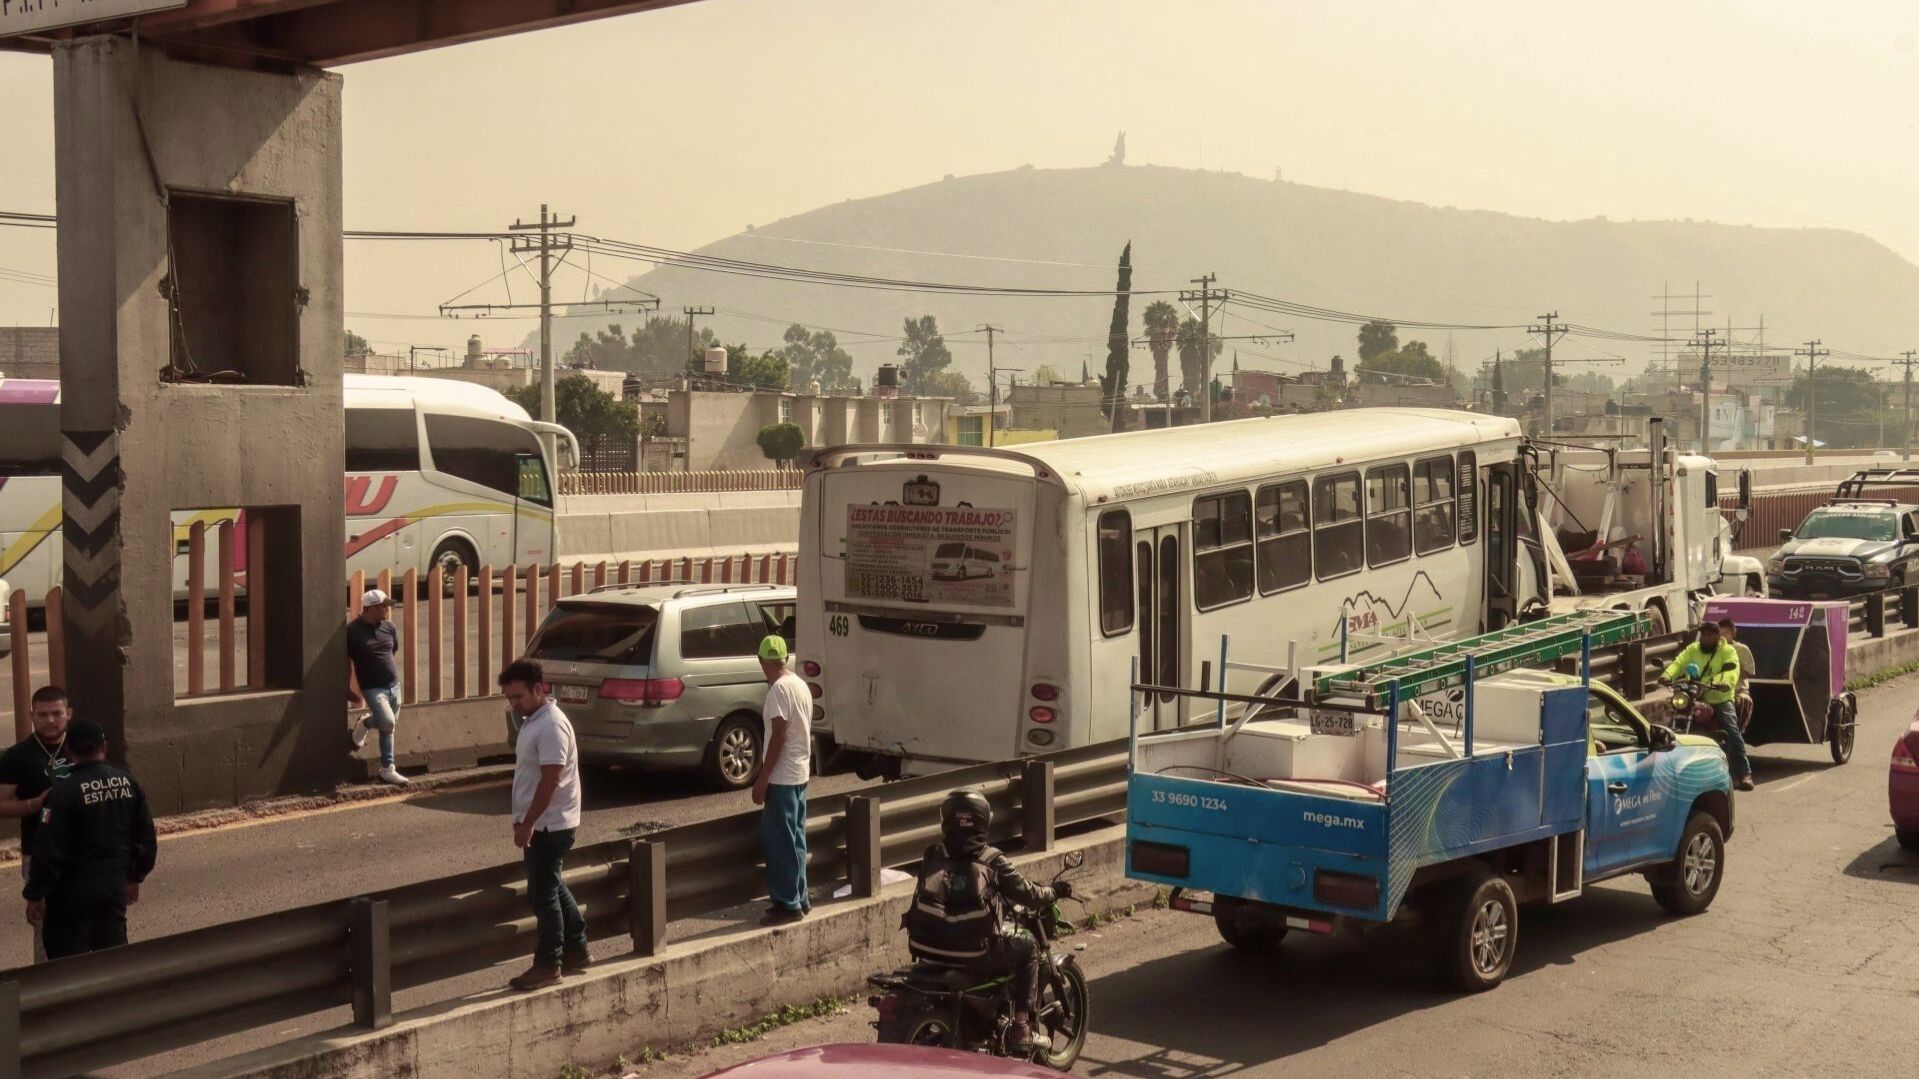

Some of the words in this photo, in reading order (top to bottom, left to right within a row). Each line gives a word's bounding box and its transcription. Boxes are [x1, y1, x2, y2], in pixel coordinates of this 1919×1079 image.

[887, 510, 942, 524] BUSCANDO
[946, 512, 1001, 527] TRABAJO?
[1788, 606, 1805, 620] 142
[829, 614, 849, 637] 469
[80, 776, 131, 793] POLICIA
[84, 788, 133, 805] ESTATAL
[1151, 790, 1166, 804] 33
[1168, 793, 1198, 808] 9690
[1200, 796, 1229, 812] 1234
[1303, 810, 1366, 831] mega.mx
